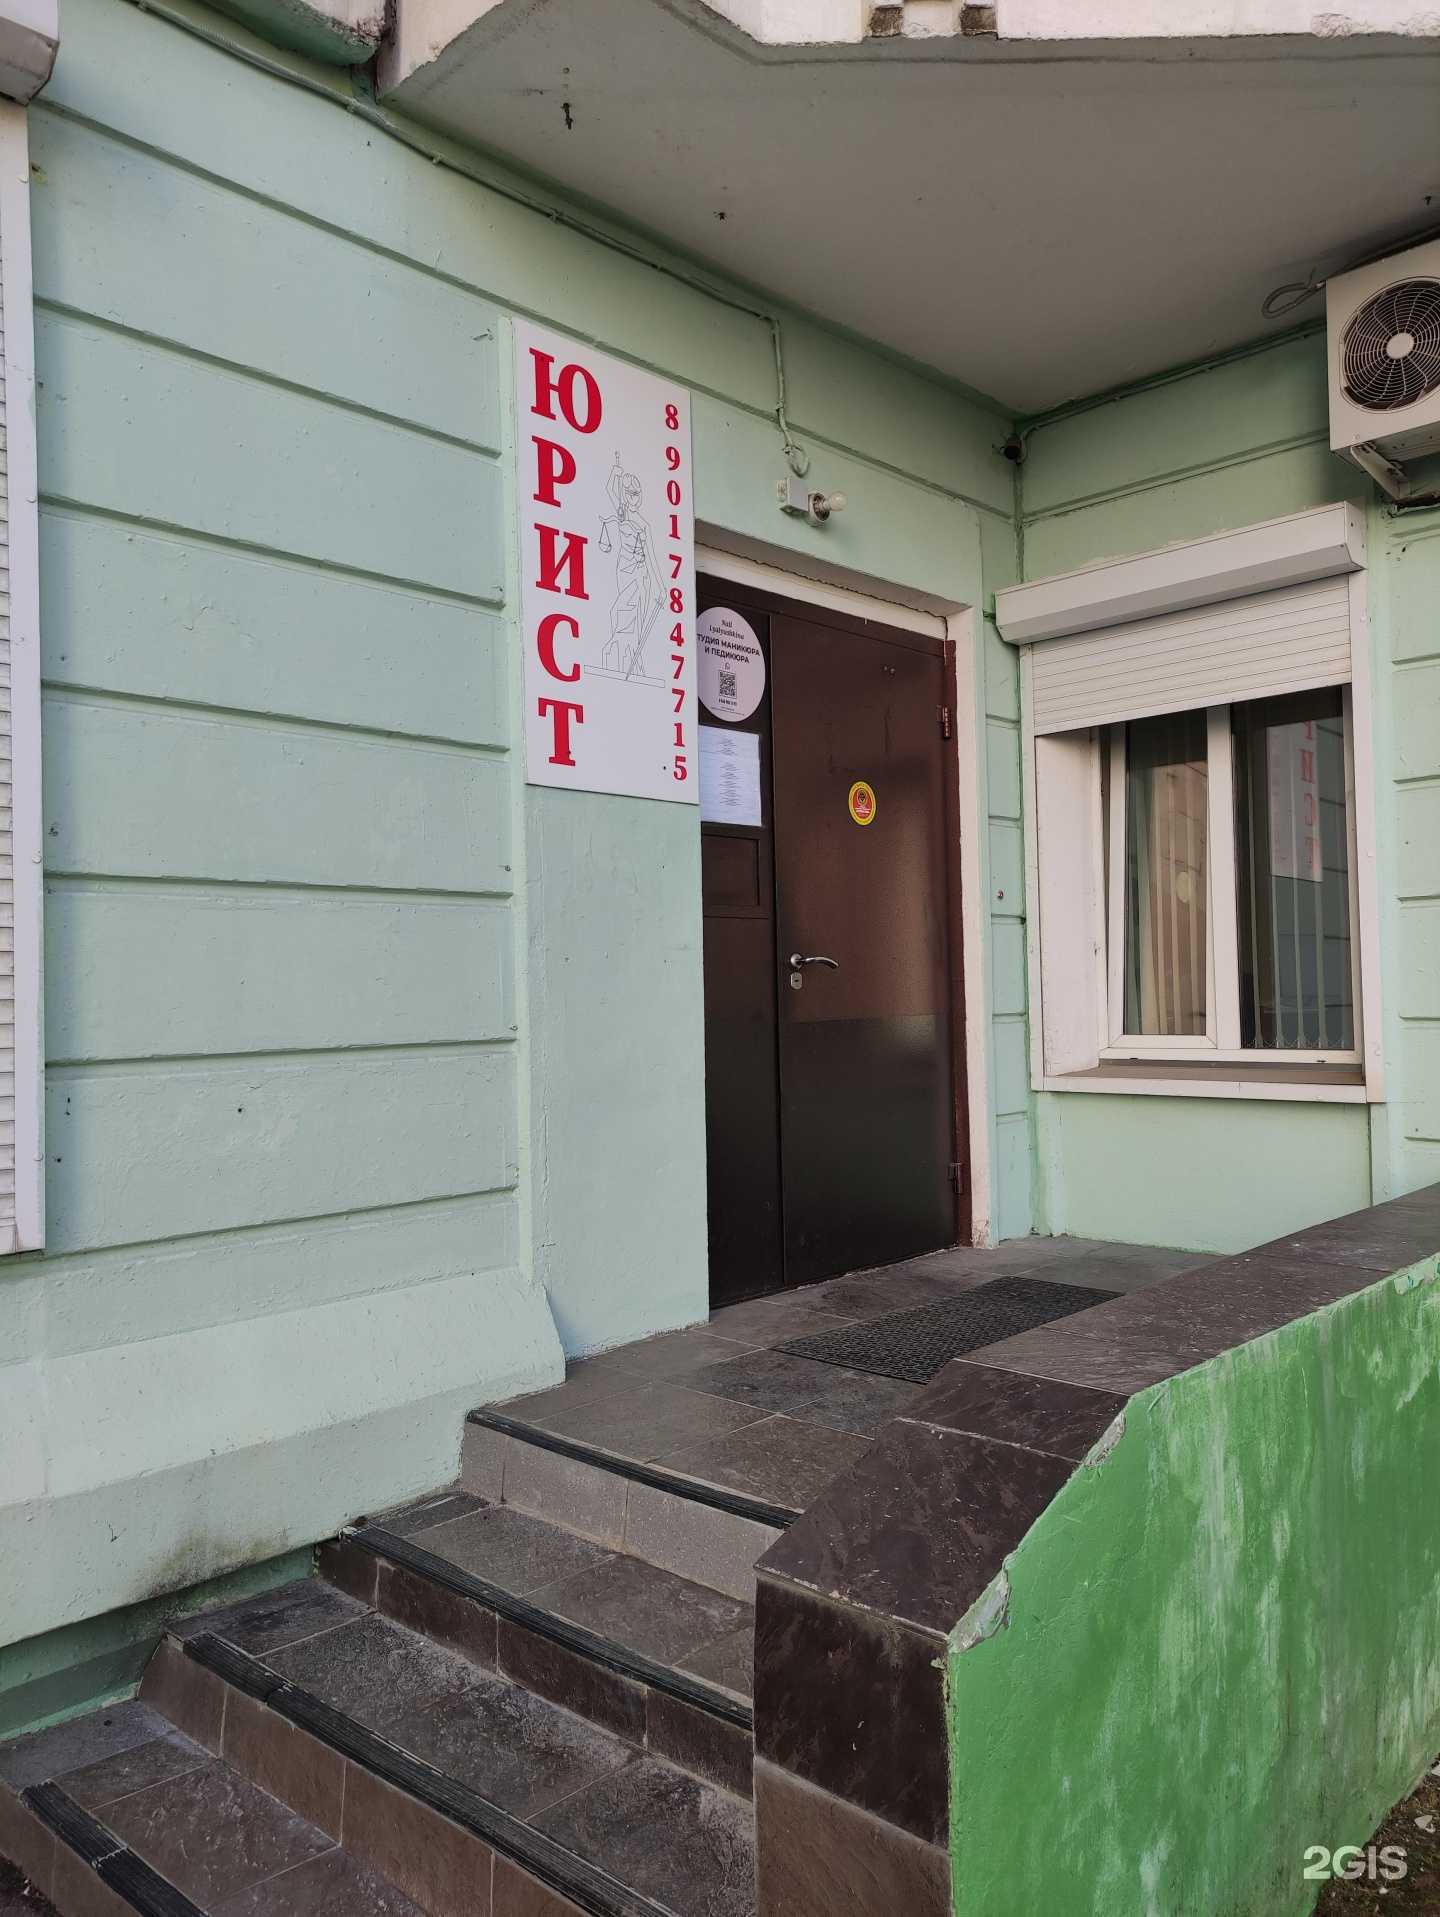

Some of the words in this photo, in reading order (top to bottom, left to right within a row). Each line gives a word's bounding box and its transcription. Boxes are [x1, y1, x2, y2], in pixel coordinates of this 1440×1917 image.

[528, 347, 603, 768] ЮРИСТ
[697, 633, 720, 646] ТУДИЯ
[721, 640, 761, 657] МАНИКЮРА
[704, 646, 710, 655] И
[711, 647, 750, 664] ПЕДИКЮРА
